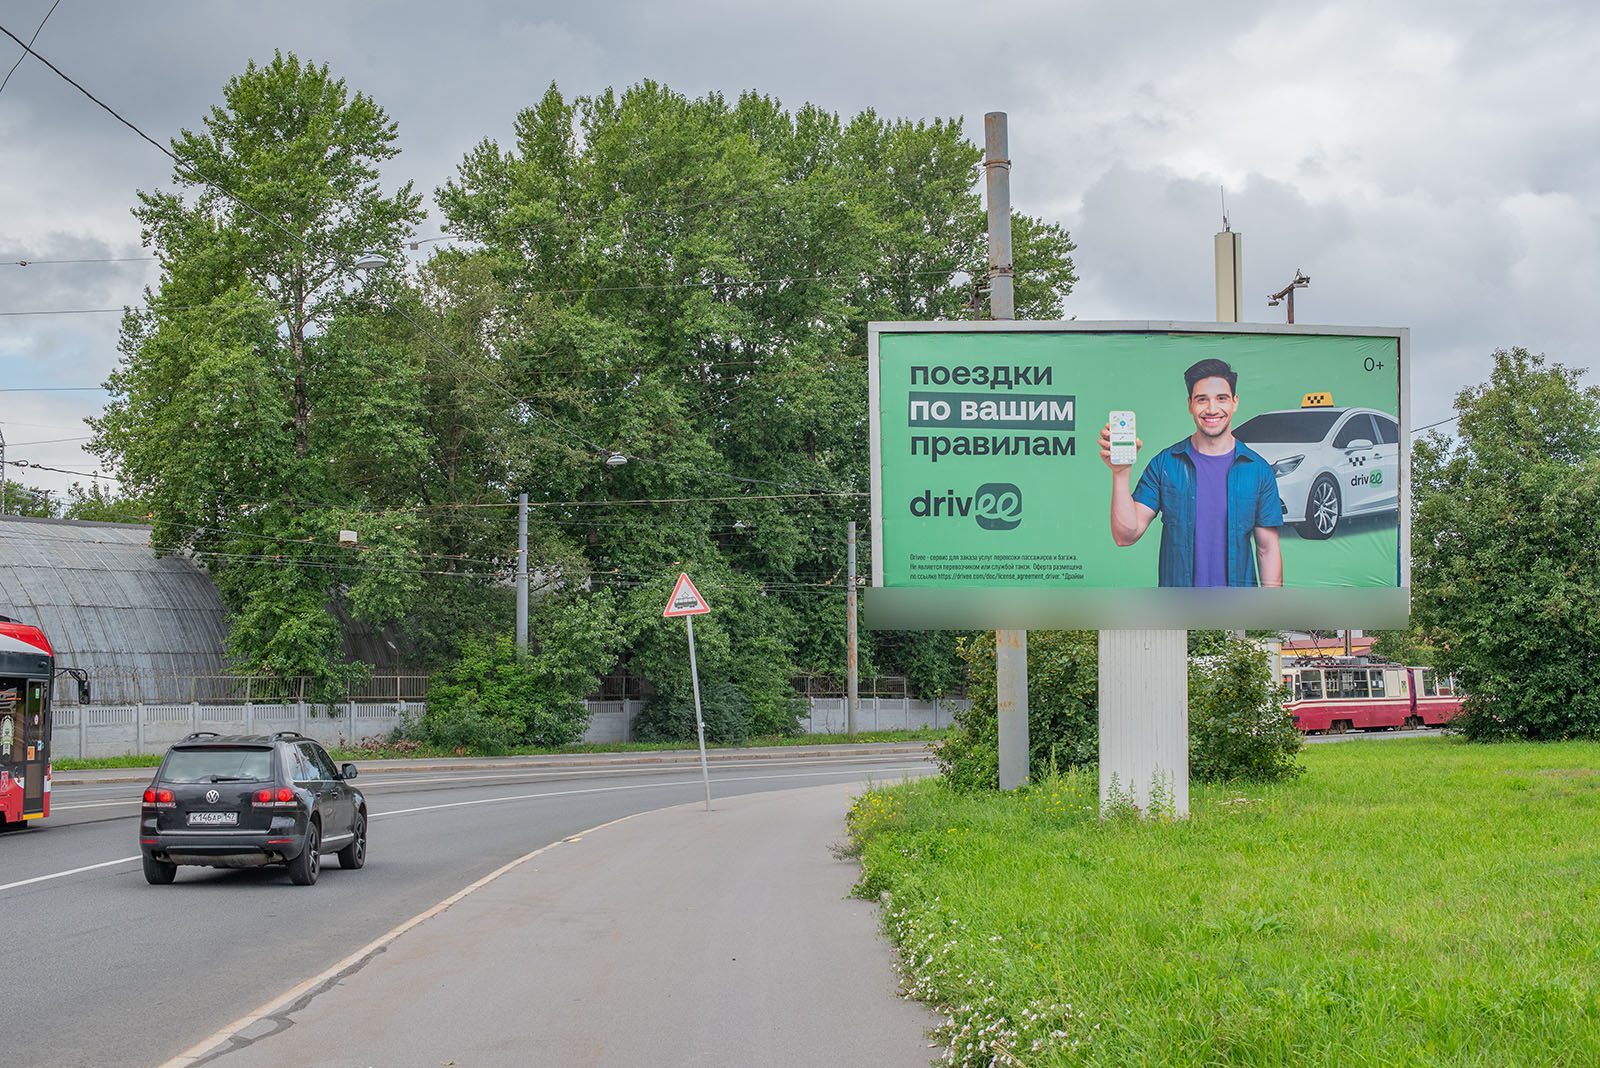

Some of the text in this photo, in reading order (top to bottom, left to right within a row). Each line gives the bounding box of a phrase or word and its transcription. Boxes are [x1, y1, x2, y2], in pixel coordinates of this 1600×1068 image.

[1363, 356, 1384, 372] 0+
[910, 365, 1052, 390] поездки
[910, 400, 1074, 421] по вашим
[910, 435, 1076, 463] правилам
[1350, 468, 1384, 488] drivee
[909, 487, 1023, 526] drivee
[929, 554, 948, 562] сервис
[948, 554, 960, 562] для
[978, 554, 993, 562] услуг
[993, 554, 1021, 562] перевозки
[1021, 554, 1053, 562] пассажиров
[991, 563, 1014, 571] службой
[1032, 563, 1052, 571] Оферта
